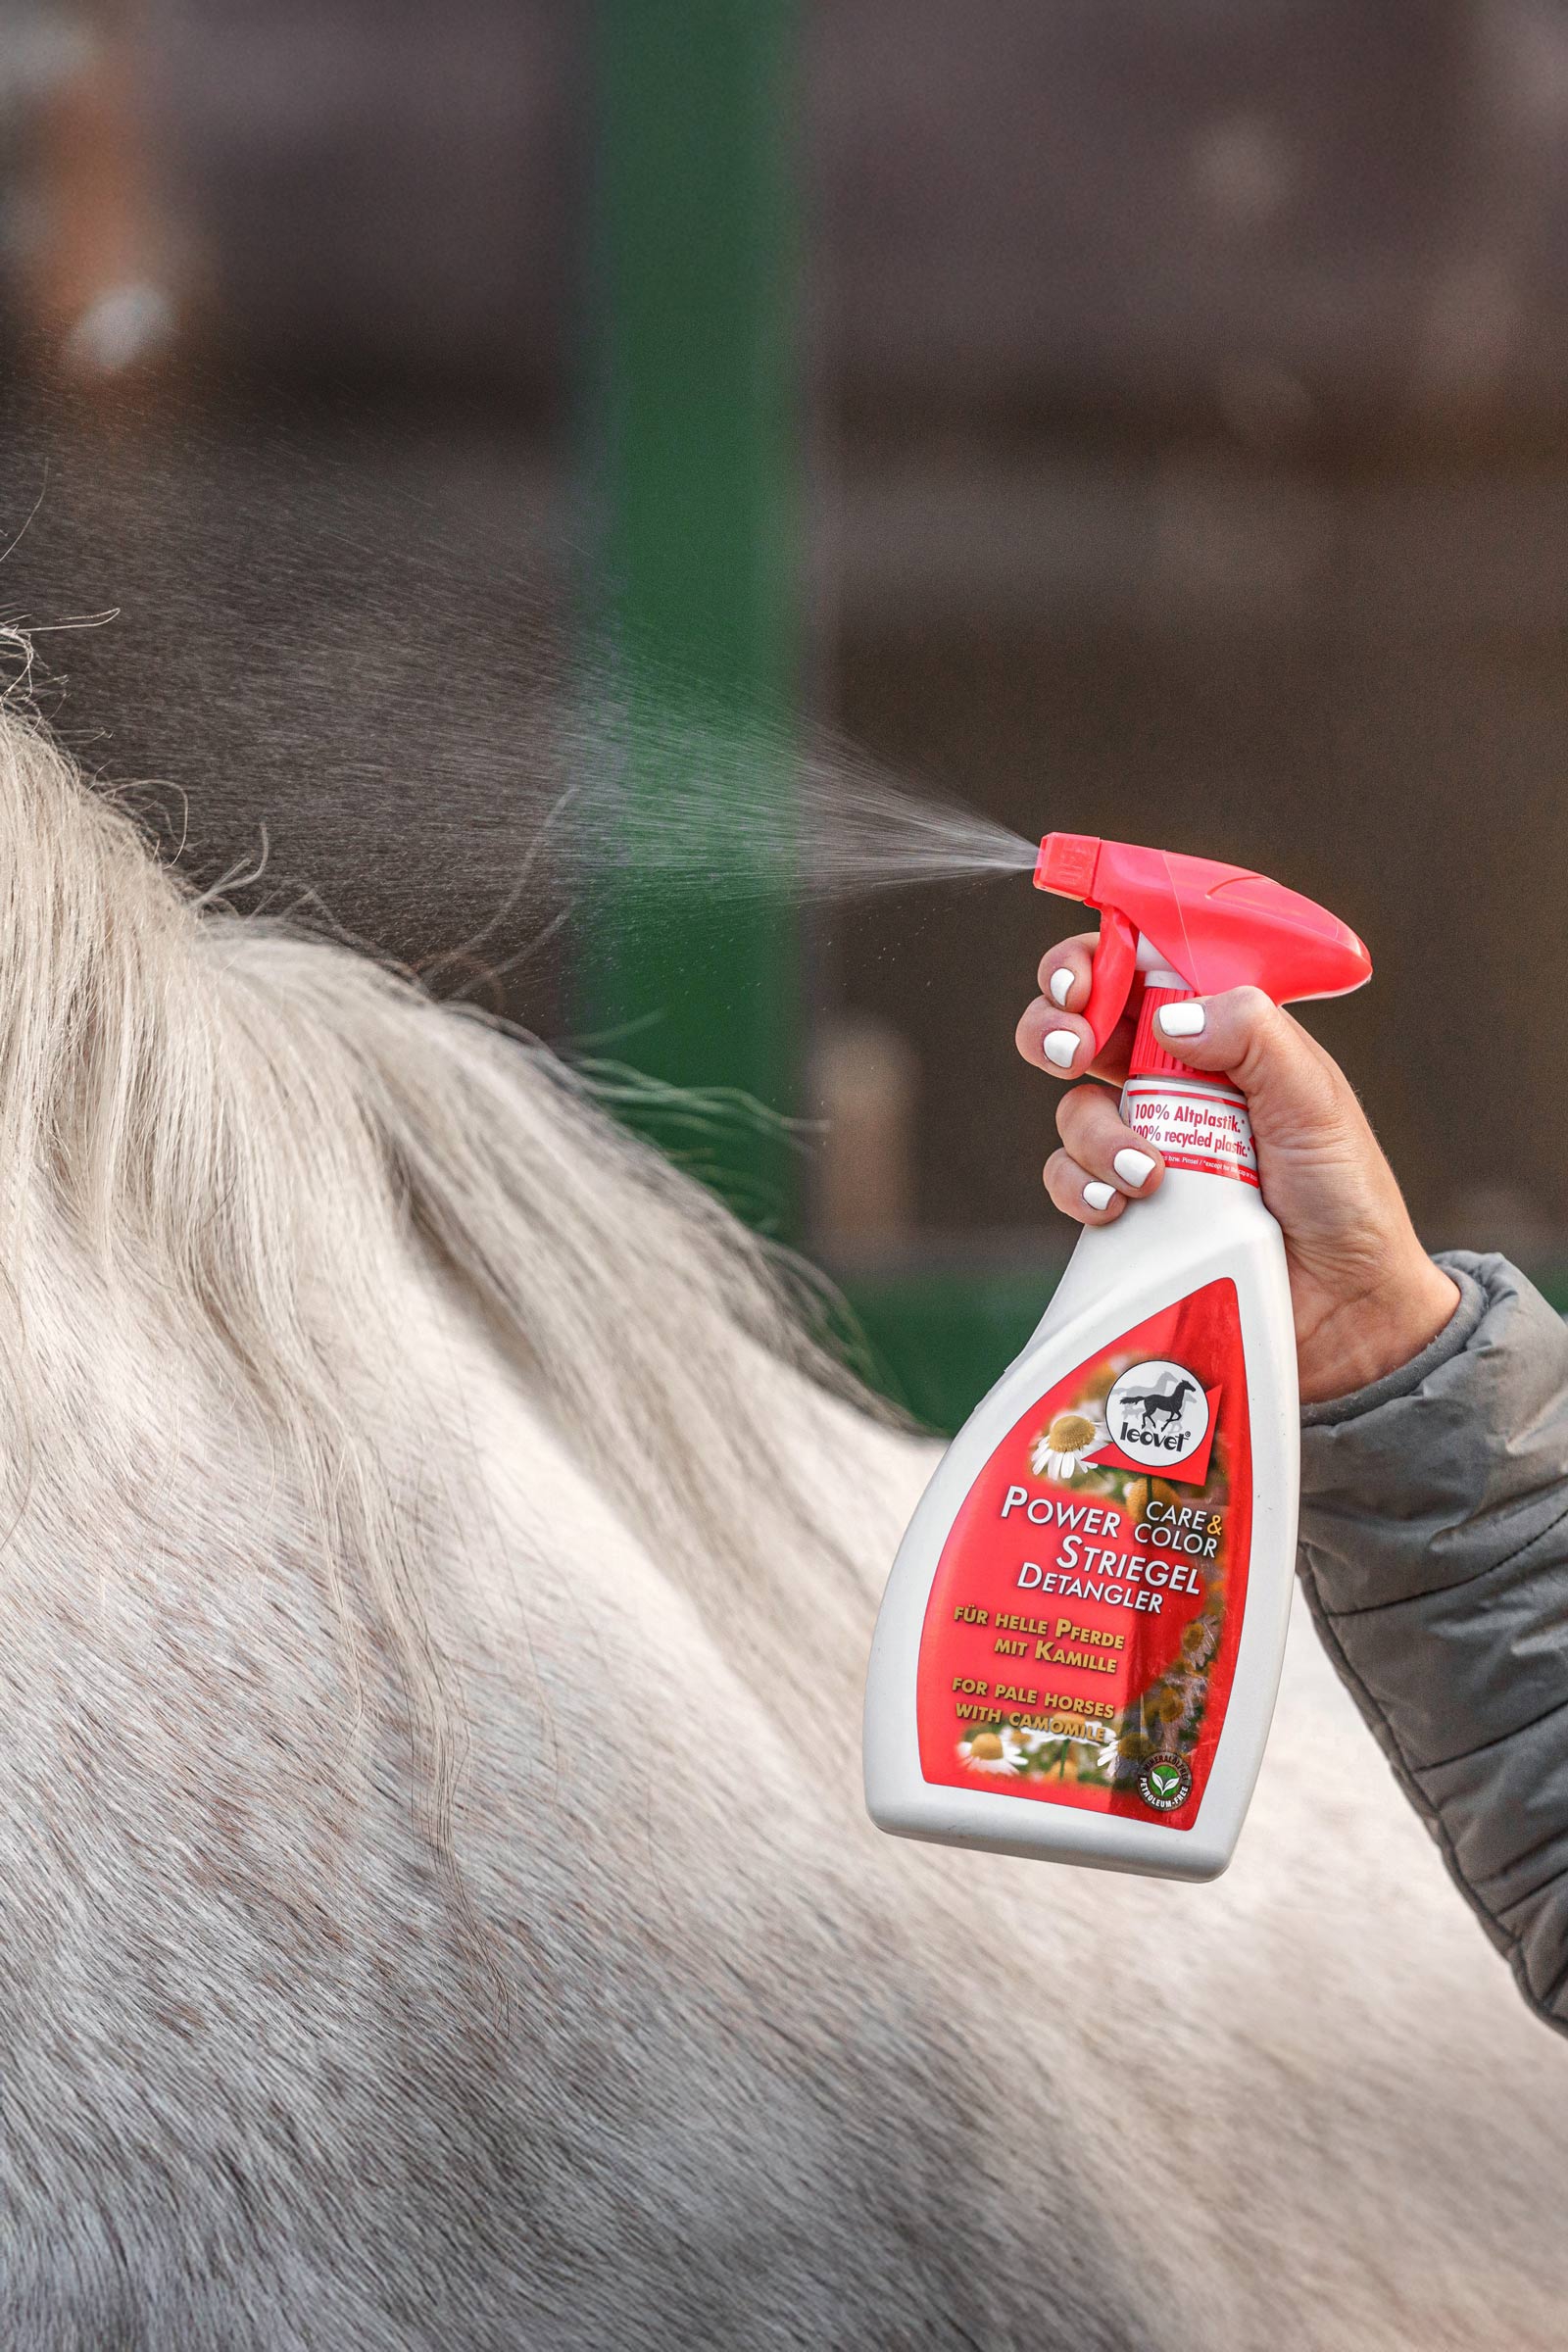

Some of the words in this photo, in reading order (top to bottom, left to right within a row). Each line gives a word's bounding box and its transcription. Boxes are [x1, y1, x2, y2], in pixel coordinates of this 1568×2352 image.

[1135, 1103, 1170, 1120] 100%
[1164, 1129, 1213, 1148] recycled
[1001, 1486, 1121, 1539] POWER
[1134, 1523, 1218, 1558] COLOR
[1056, 1535, 1201, 1595] STRIEGEL
[1016, 1562, 1164, 1614] DETANGLER
[954, 1604, 989, 1626] FÜR
[995, 1613, 1049, 1636] HELLE
[1054, 1618, 1126, 1650] PFERDE
[994, 1638, 1028, 1658] MIT
[1035, 1640, 1118, 1675] KAMILLE
[952, 1677, 989, 1696] FOR
[995, 1684, 1038, 1705] PALE
[1044, 1692, 1115, 1720] HORSES
[956, 1702, 1003, 1724] WITH
[1008, 1712, 1106, 1743] CAMOMILE
[1140, 1777, 1189, 1808] PETROLEUM-FREE
